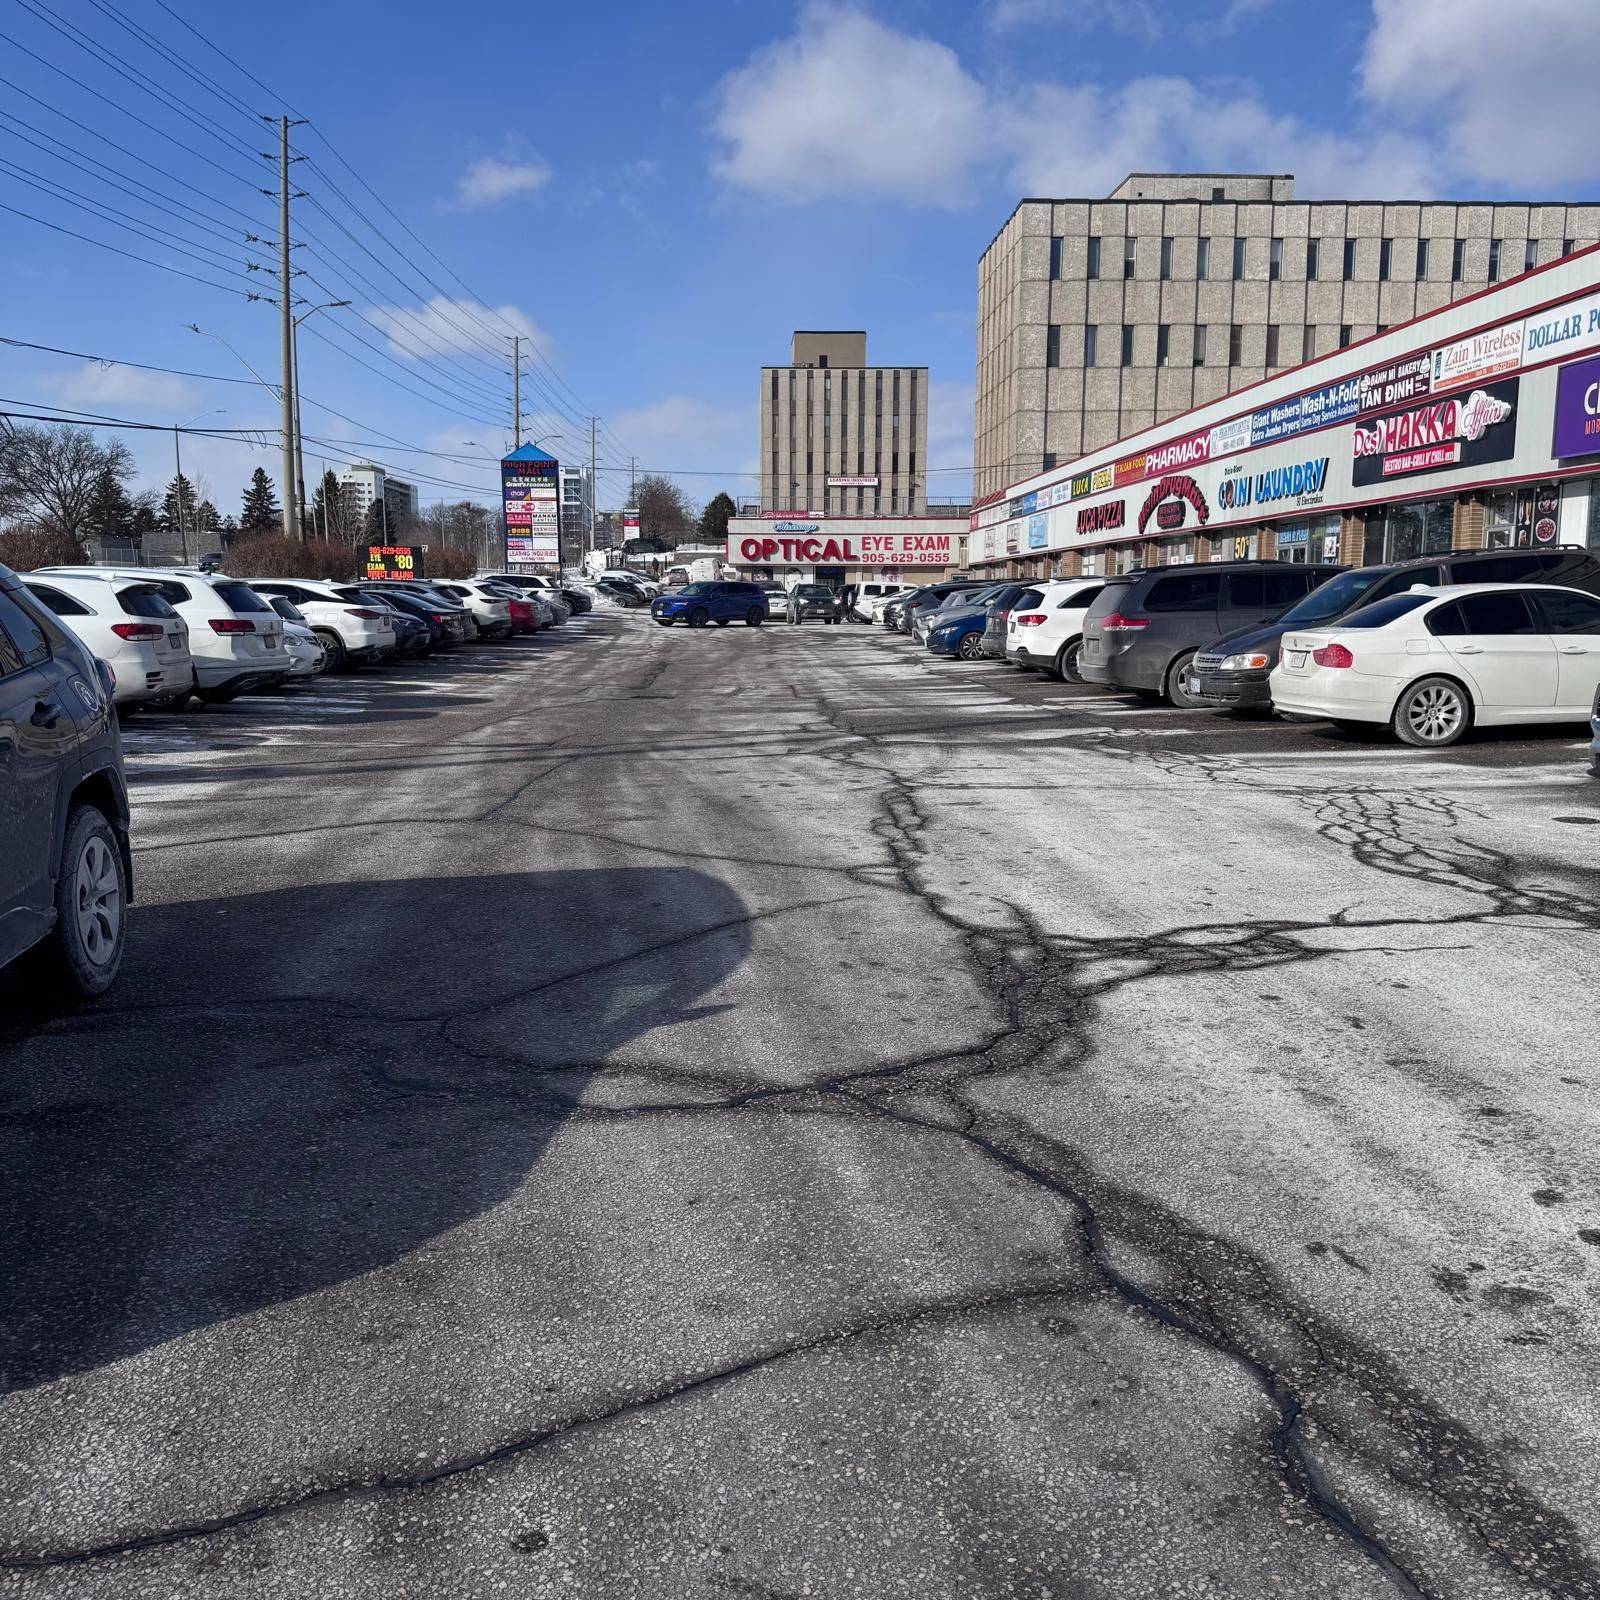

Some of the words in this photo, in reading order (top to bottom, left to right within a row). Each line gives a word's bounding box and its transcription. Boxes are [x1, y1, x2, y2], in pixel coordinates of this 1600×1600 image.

[1528, 314, 1581, 351] DOLLAR
[1445, 344, 1469, 367] Zain
[1473, 329, 1521, 358] Wireless
[1371, 371, 1387, 386] BÁNH
[1389, 366, 1396, 381] MÌ
[1398, 359, 1421, 378] BAKERY
[1361, 387, 1381, 409] TÂN
[1385, 378, 1414, 403] ĐỊNH
[1253, 411, 1270, 430] Giant
[1271, 403, 1300, 423] Washers
[1301, 418, 1312, 428] Same
[1312, 413, 1321, 425] Day
[1321, 409, 1337, 421] Service
[1338, 402, 1358, 416] Available
[1385, 400, 1457, 453] HAKKA
[1252, 430, 1265, 442] Extra
[1265, 422, 1281, 438] Jumbo
[1282, 420, 1300, 434] Dryers
[1115, 461, 1133, 474] ITALIAN
[1133, 457, 1145, 470] FOOD
[1145, 434, 1210, 473] PHARMACY
[1072, 477, 1088, 495] LUCA
[1218, 477, 1250, 509] COIN
[1254, 458, 1326, 503] LAUNDRY
[1076, 507, 1096, 533] LUCA
[1097, 500, 1123, 529] PIZZA
[369, 546, 411, 554] 905-629-0555
[741, 538, 859, 561] OPTICAL
[861, 537, 893, 551] EYE
[903, 537, 950, 551] EXAM
[370, 554, 382, 562] EYE
[395, 555, 413, 569] $80
[862, 553, 950, 563] 905-629-0555
